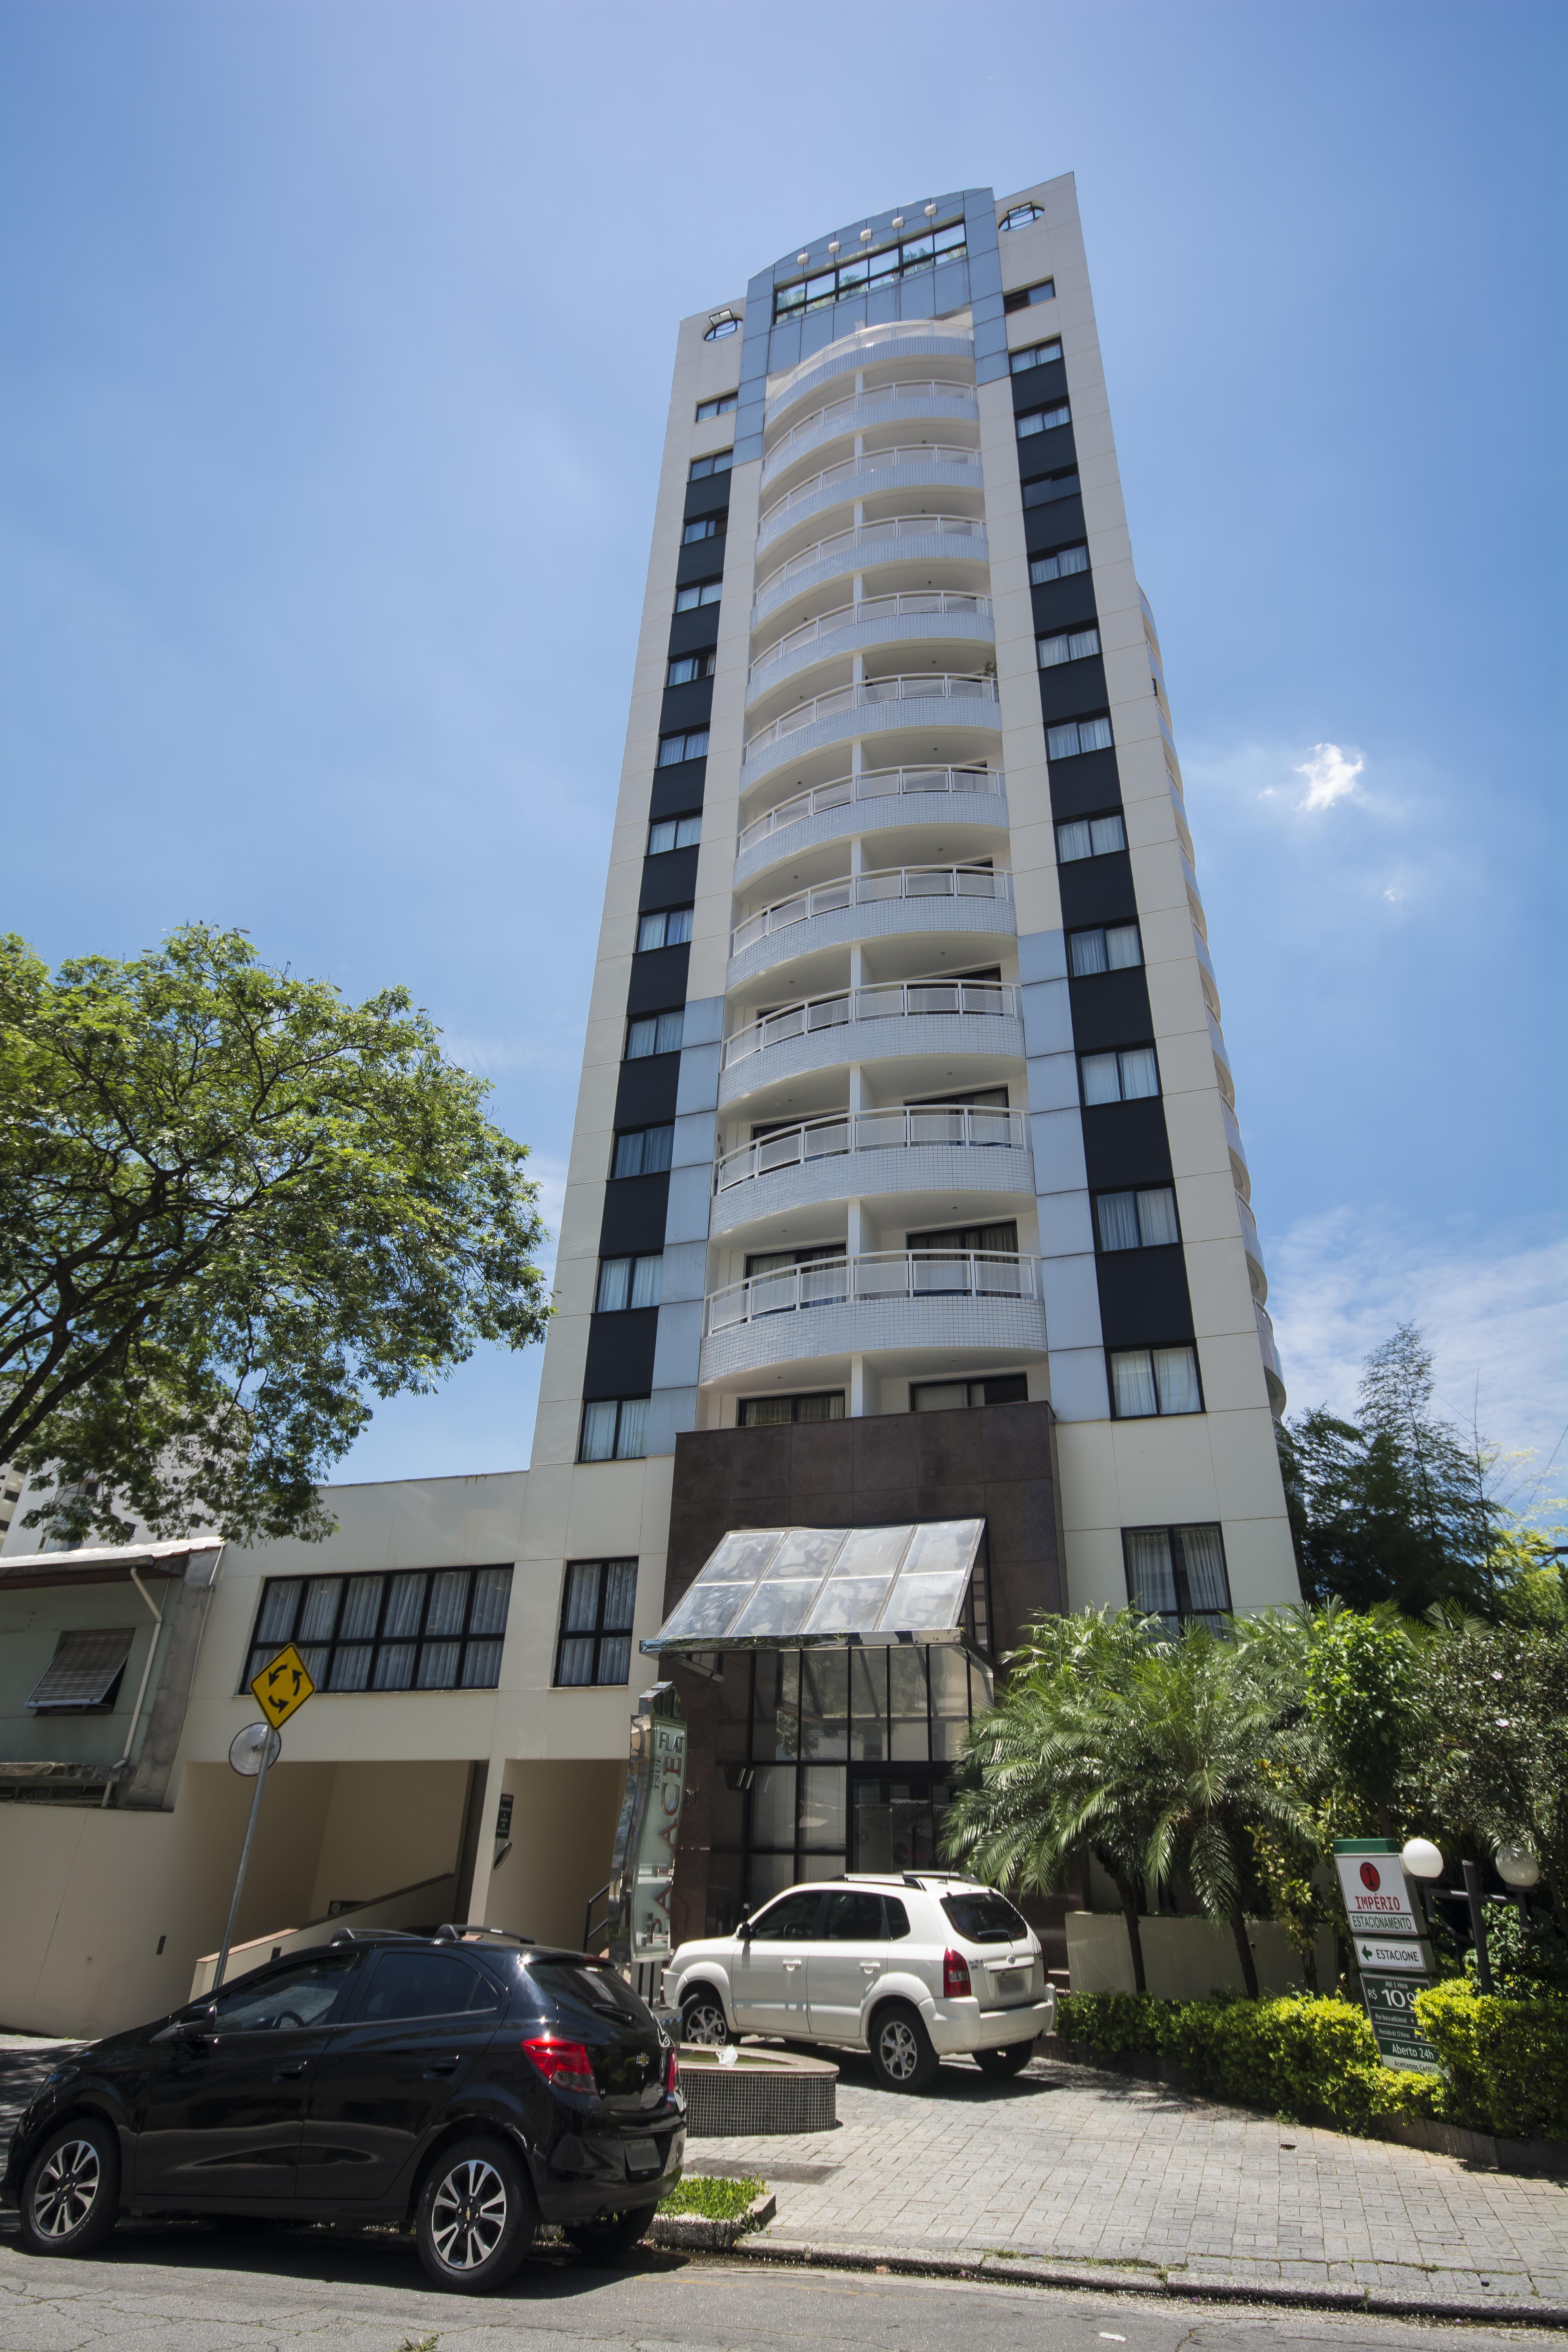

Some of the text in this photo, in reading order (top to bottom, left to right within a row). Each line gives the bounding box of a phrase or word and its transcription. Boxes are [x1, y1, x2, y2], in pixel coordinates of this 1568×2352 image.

[659, 1731, 685, 1754] FLAT
[1355, 1893, 1401, 1911] IMPÉRIO
[1352, 1916, 1412, 1929] ESTACIONAMENTO
[1376, 1949, 1419, 1962] ESTACIONE
[1368, 1989, 1377, 2000] R$
[1392, 2043, 1434, 2060] Aberto 24h
[1395, 2060, 1419, 2070] Aceitamos
